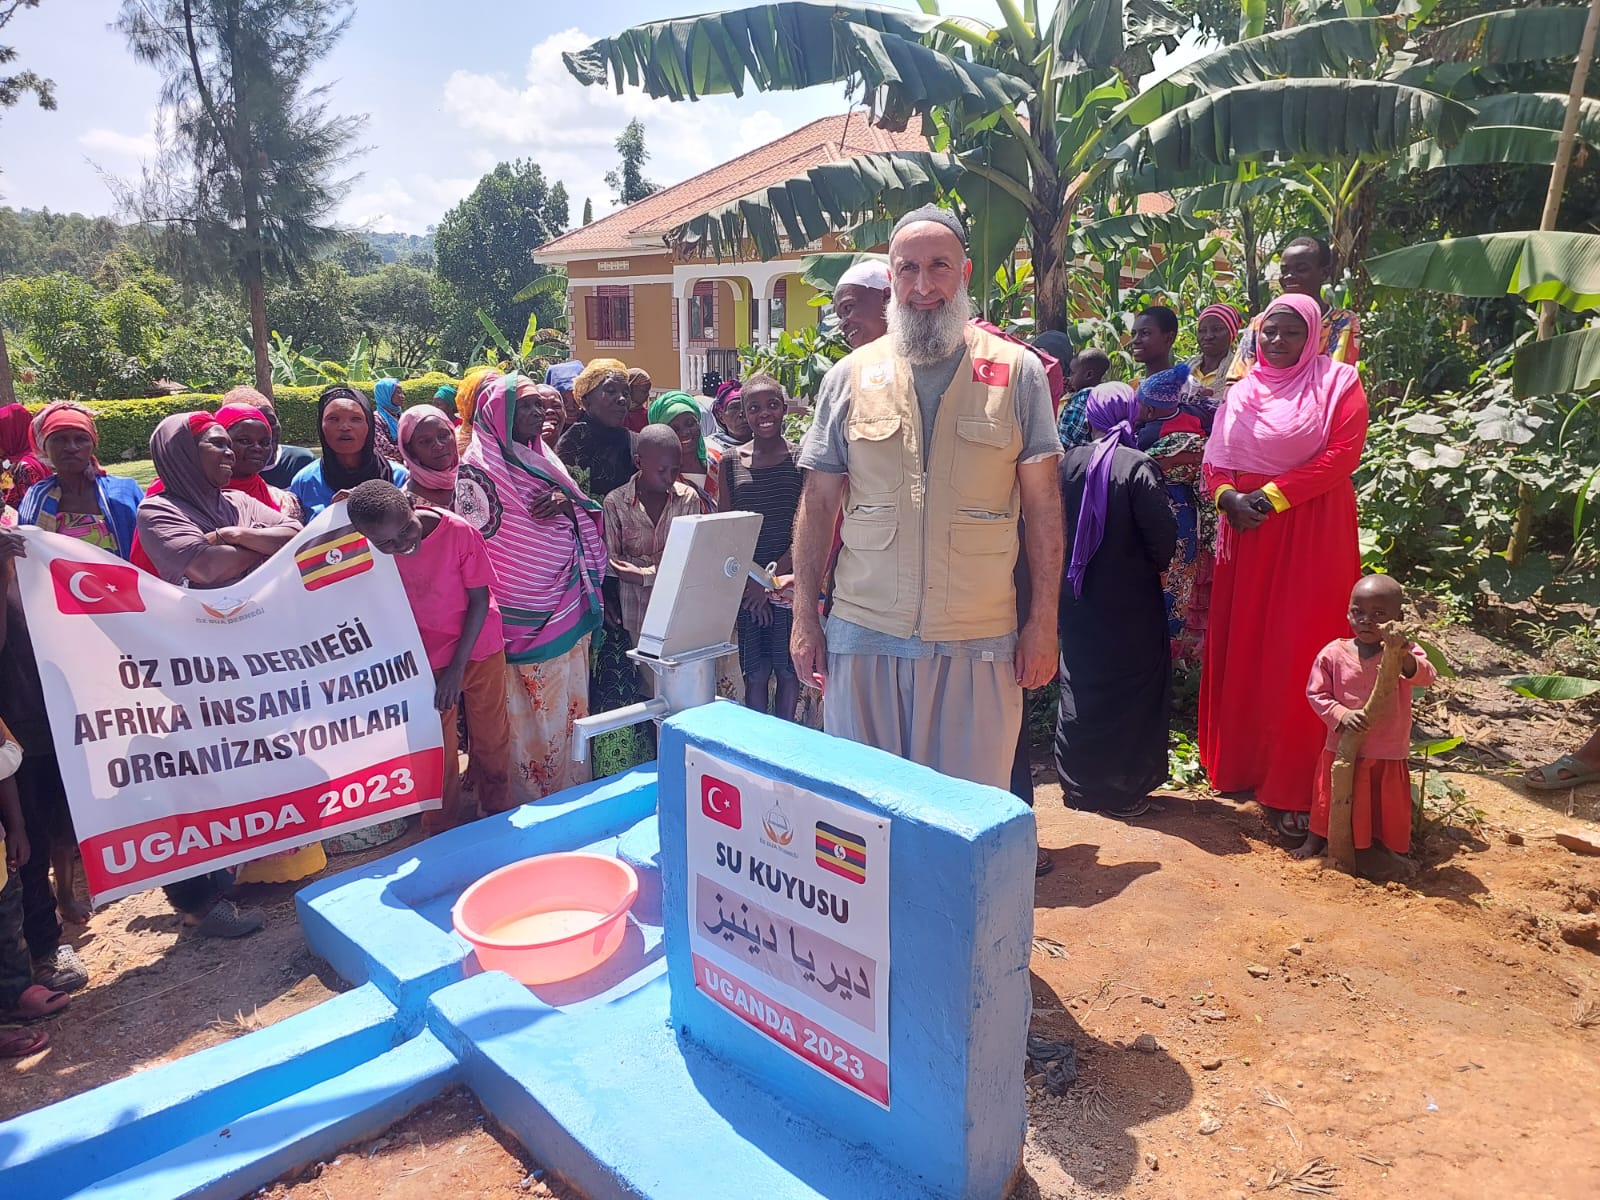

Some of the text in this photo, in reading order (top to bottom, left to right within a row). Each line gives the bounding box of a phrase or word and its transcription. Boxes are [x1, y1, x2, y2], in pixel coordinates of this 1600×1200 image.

[73, 650, 419, 746] AFRİKA İNSANİ YARDIM
[118, 616, 373, 690] ÖZ DUA DERNEĞİ
[107, 699, 410, 788] ORGANİZASYONLARI
[101, 767, 415, 874] UGANDA 2023
[716, 841, 849, 924] SU KUYUSU
[703, 893, 871, 1000] ديريا دينيز
[705, 967, 865, 1081] UGANDA 2023
